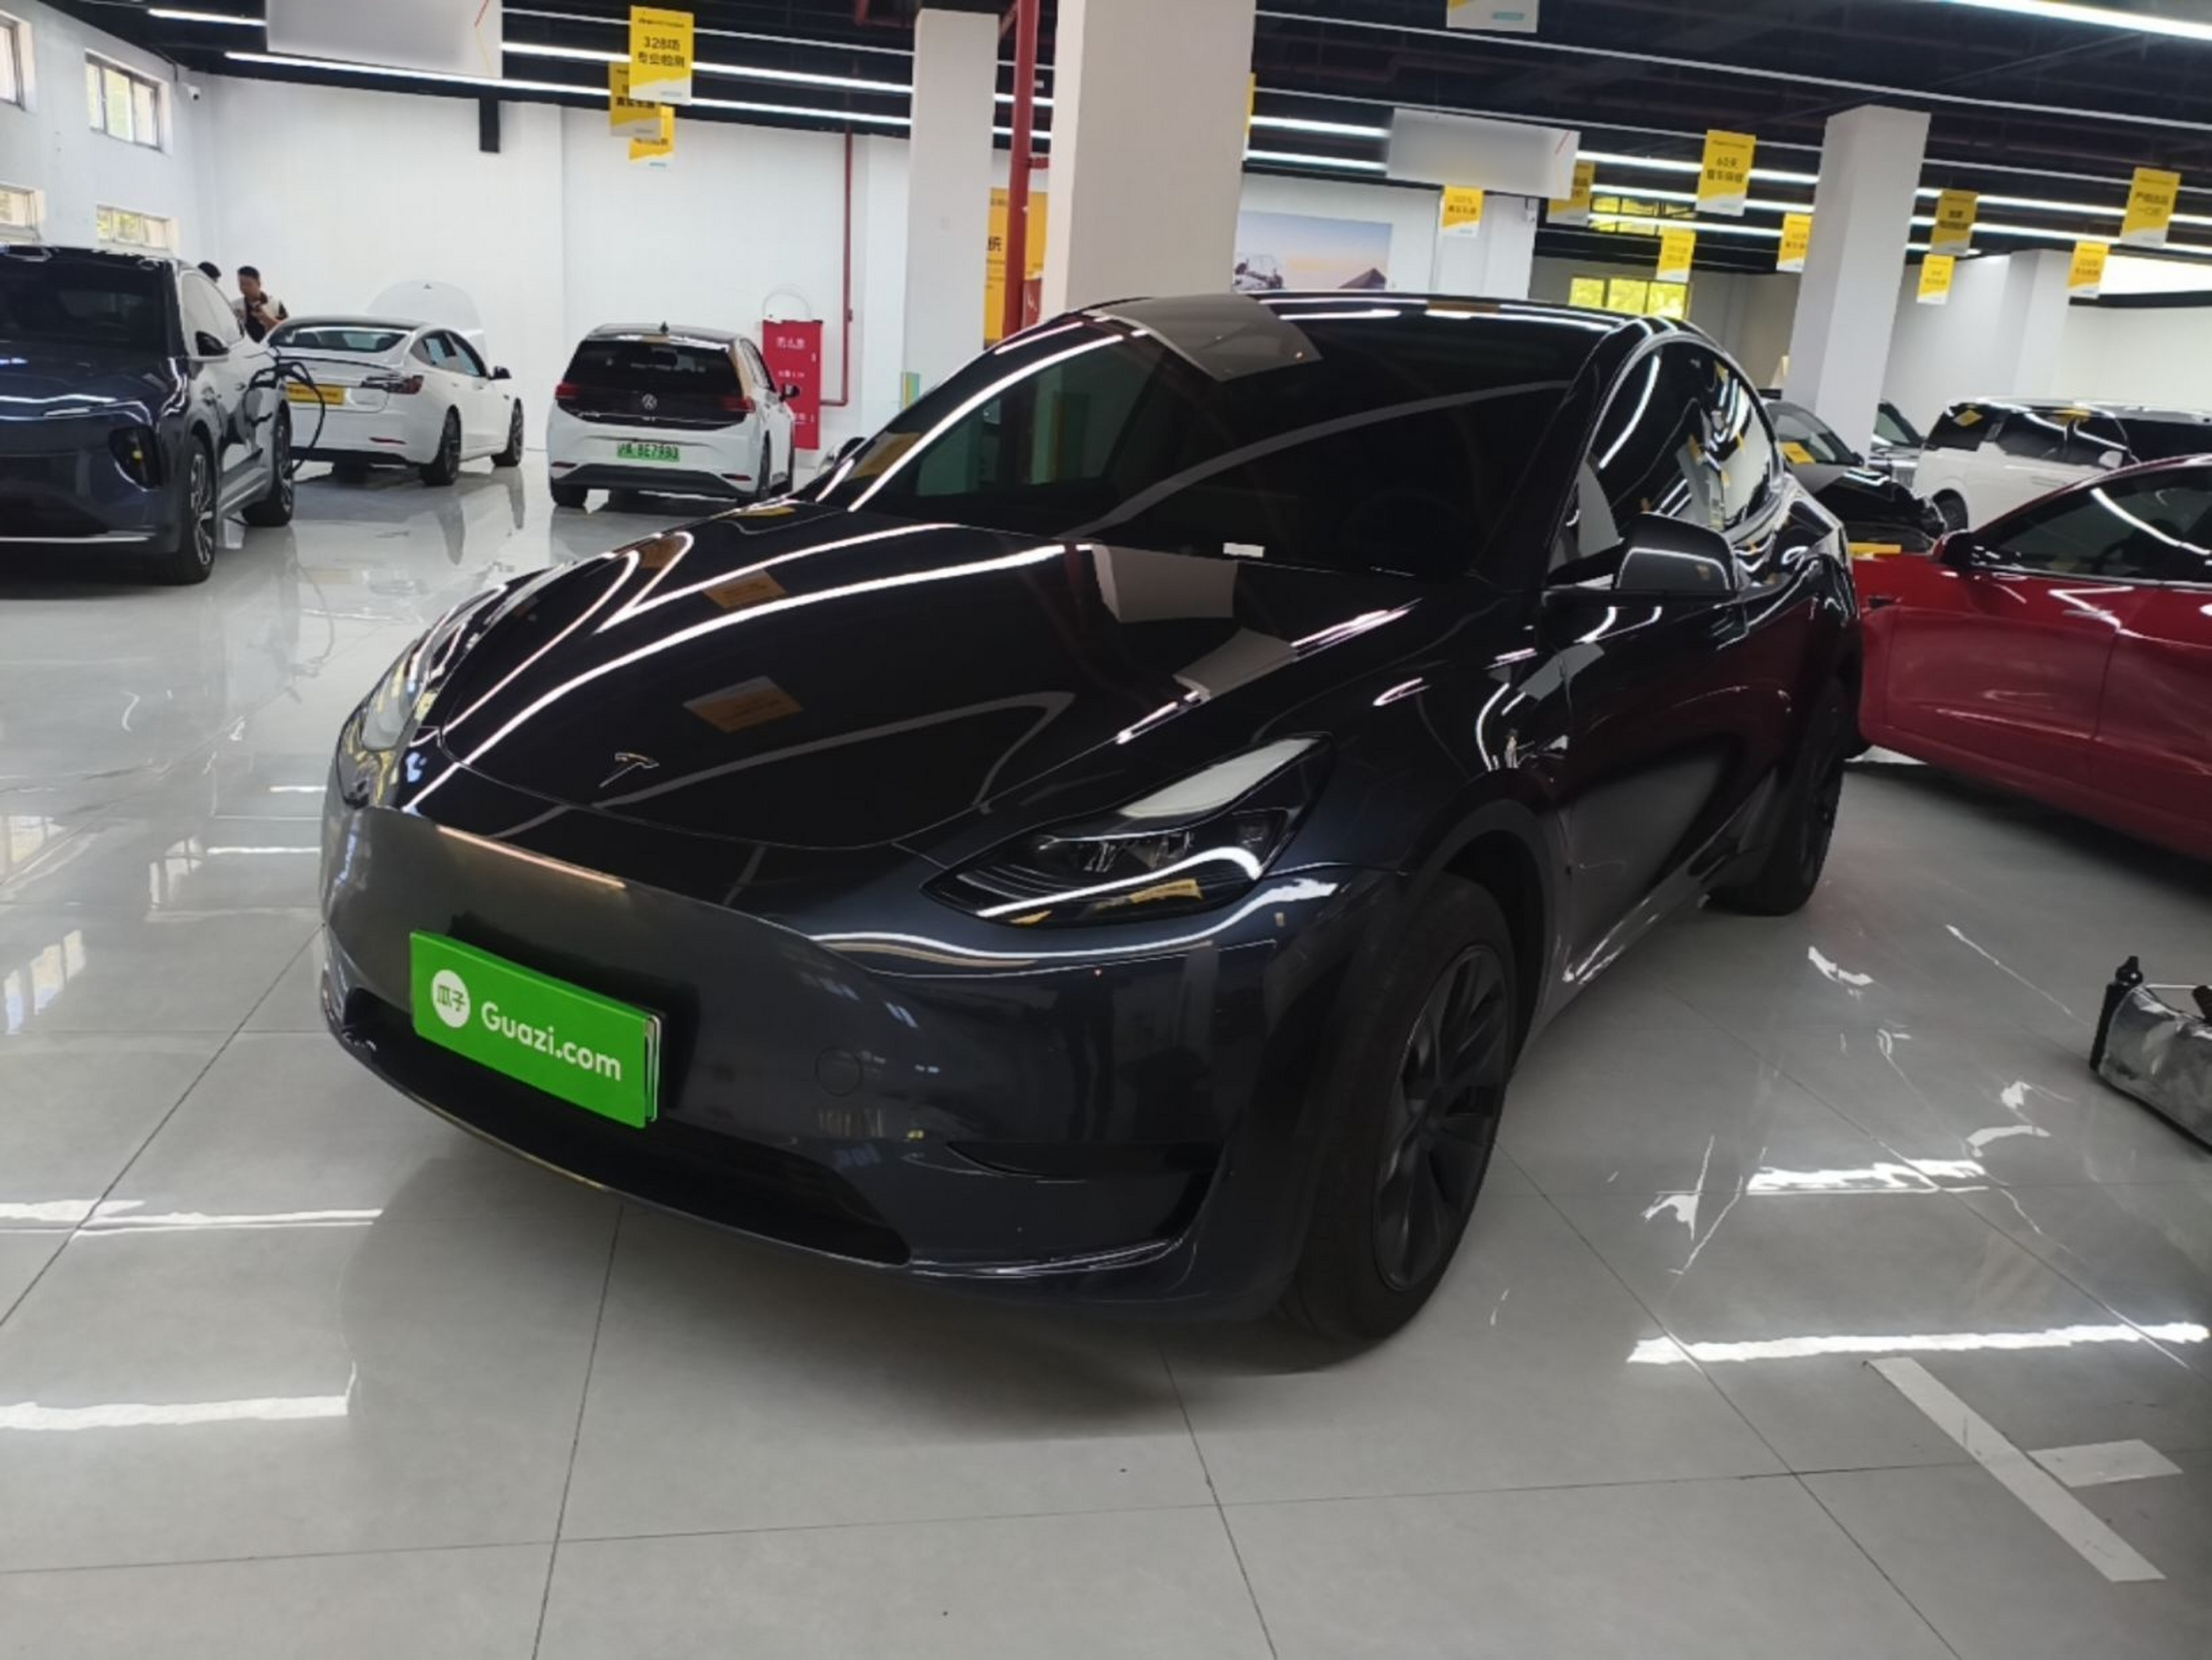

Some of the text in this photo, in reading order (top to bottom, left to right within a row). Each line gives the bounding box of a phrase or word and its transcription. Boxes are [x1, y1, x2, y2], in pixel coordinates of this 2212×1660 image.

[638, 51, 685, 68] 专业检测
[437, 984, 465, 1012] 瓜子
[481, 1001, 622, 1082] Guazi.com
